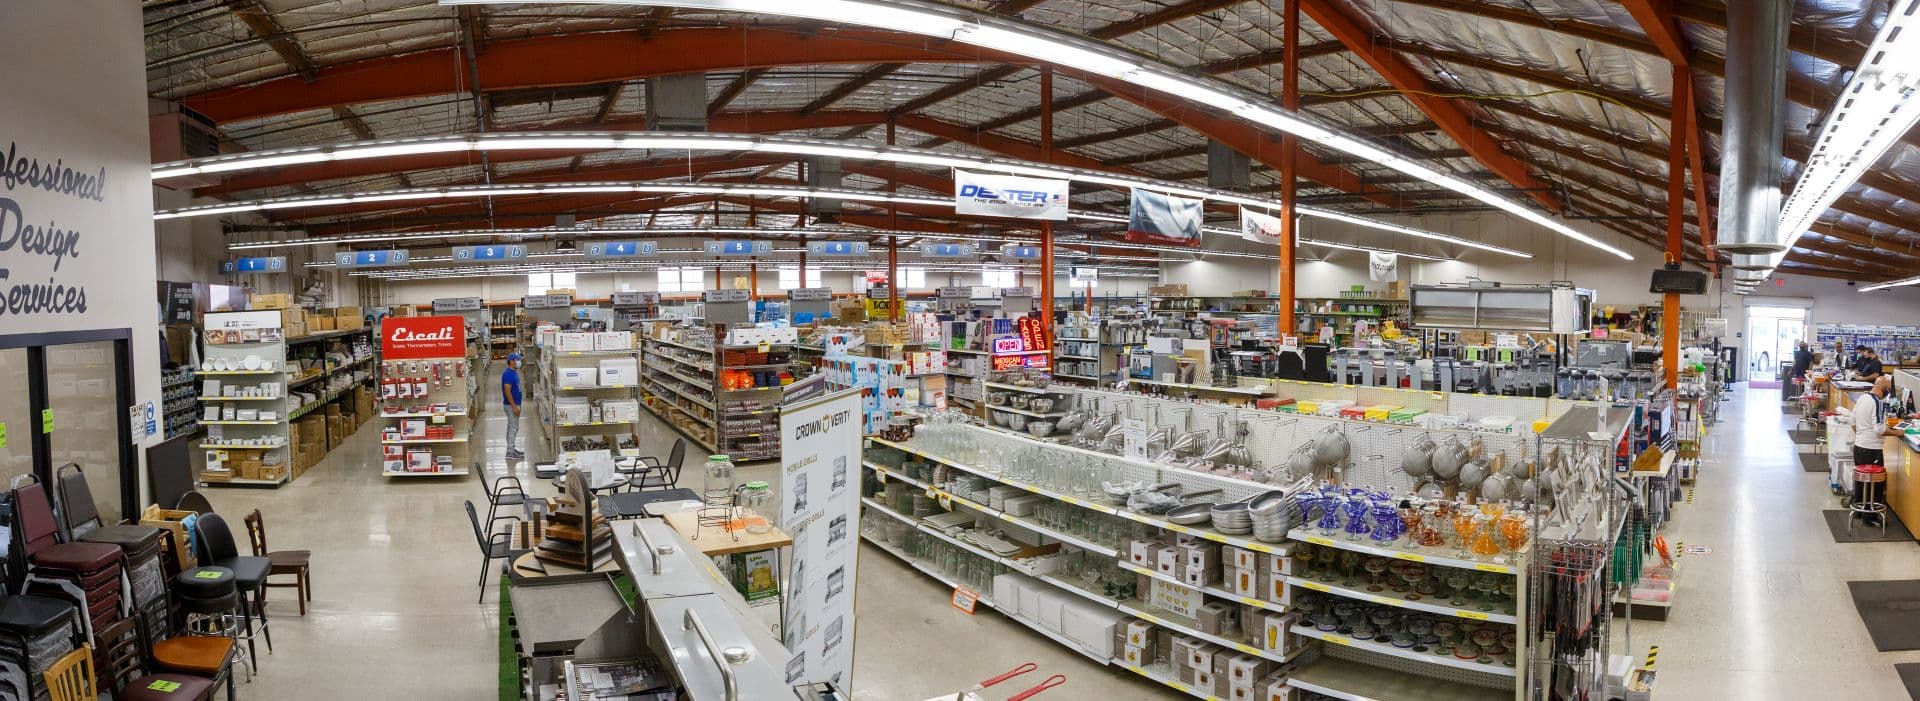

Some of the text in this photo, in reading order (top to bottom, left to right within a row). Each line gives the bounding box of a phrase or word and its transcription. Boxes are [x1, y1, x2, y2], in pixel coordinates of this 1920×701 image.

[0, 197, 80, 272] Design
[486, 248, 493, 256] 3
[617, 244, 624, 252] 4
[736, 243, 742, 251] 5
[836, 243, 842, 251] 6
[369, 254, 375, 262] 2
[393, 250, 403, 262] b
[391, 326, 455, 342] Escali
[1020, 319, 1032, 350] TACOS
[1031, 319, 1045, 350] OPEN
[997, 340, 1020, 350] OPEN
[994, 356, 1020, 364] MEXICAN
[795, 408, 851, 441] CROWN VERITY
